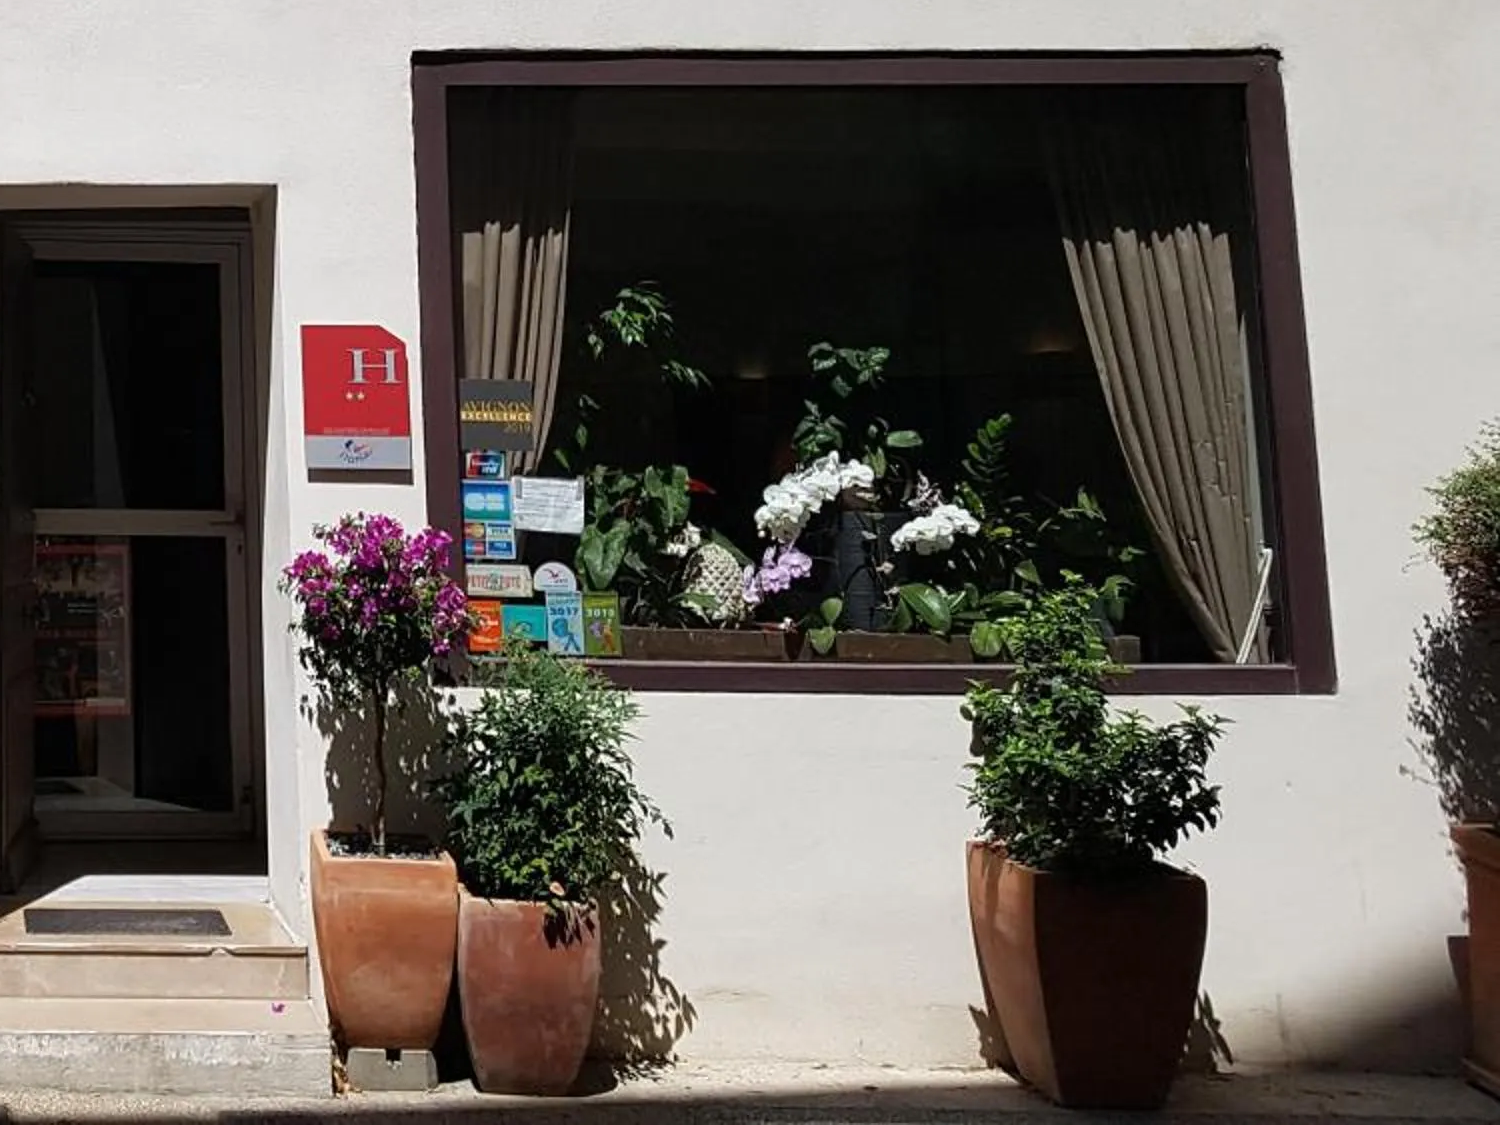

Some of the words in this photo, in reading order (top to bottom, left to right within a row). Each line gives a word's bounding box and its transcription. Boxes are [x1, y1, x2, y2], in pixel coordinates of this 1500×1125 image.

[346, 348, 402, 384] H
[462, 400, 533, 411] AVIGNON
[460, 410, 533, 422] EXCELLENCE
